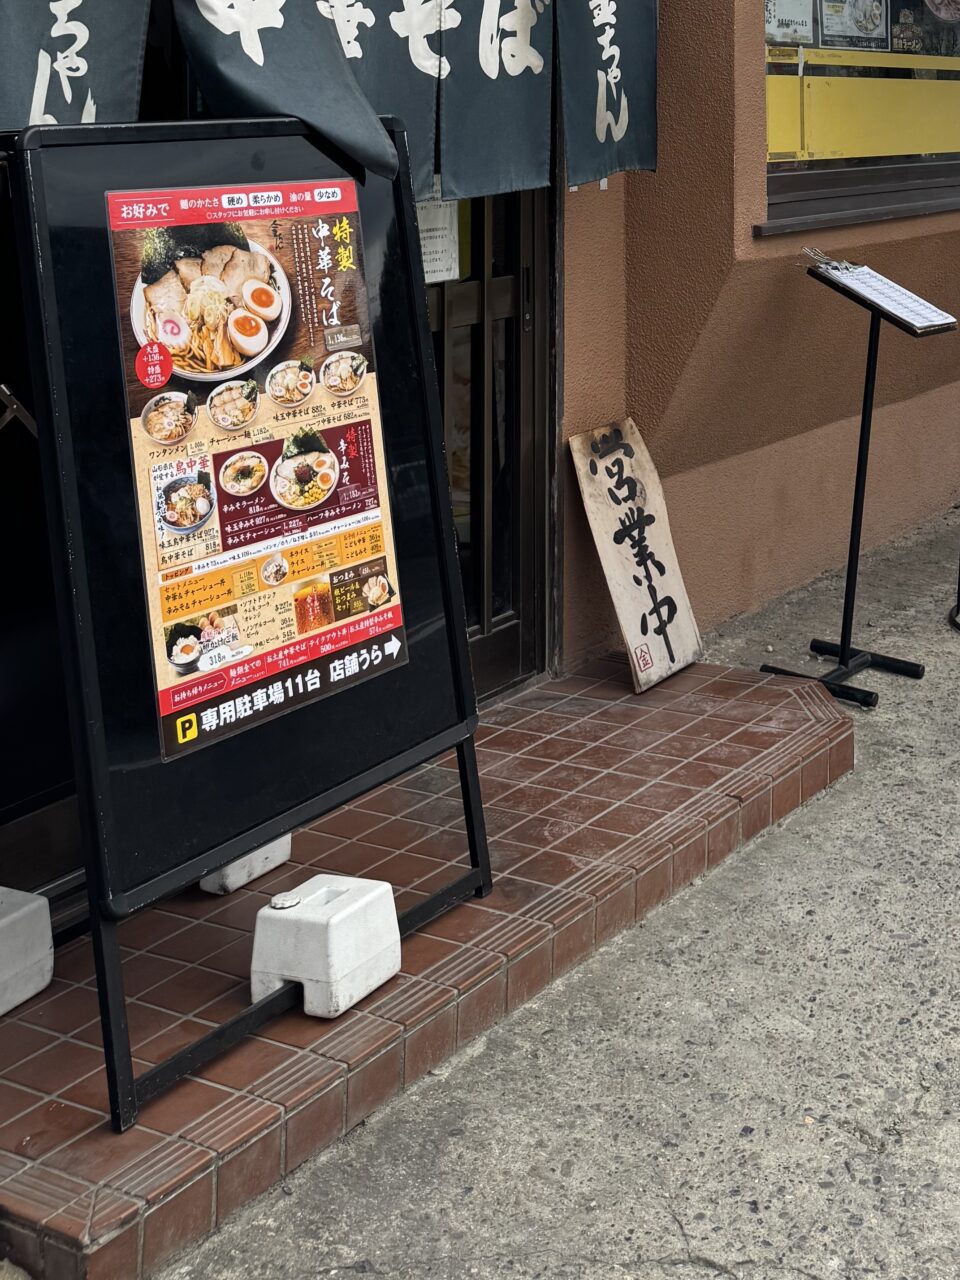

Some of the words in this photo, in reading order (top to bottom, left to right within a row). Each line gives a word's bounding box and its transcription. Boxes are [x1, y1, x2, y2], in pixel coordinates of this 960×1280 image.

[180, 197, 219, 210] 麺のかたさ
[252, 194, 281, 205] 柔らかめ
[317, 189, 339, 200] 少なめ
[120, 203, 170, 218] お好みで
[331, 215, 357, 272] 特製
[311, 218, 342, 327] 中華そば
[330, 399, 354, 410] 中華そば
[148, 445, 187, 459] ワンタンメン
[337, 438, 350, 485] 辛みそ
[222, 496, 266, 514] 辛みそラーメン
[226, 525, 282, 546] 辛みそチャーシュー
[588, 428, 678, 664] 営業中
[174, 678, 225, 703] お持ち帰りメニュー
[200, 669, 321, 732] 専用駐車場11台
[329, 645, 383, 683] 店舗うら
